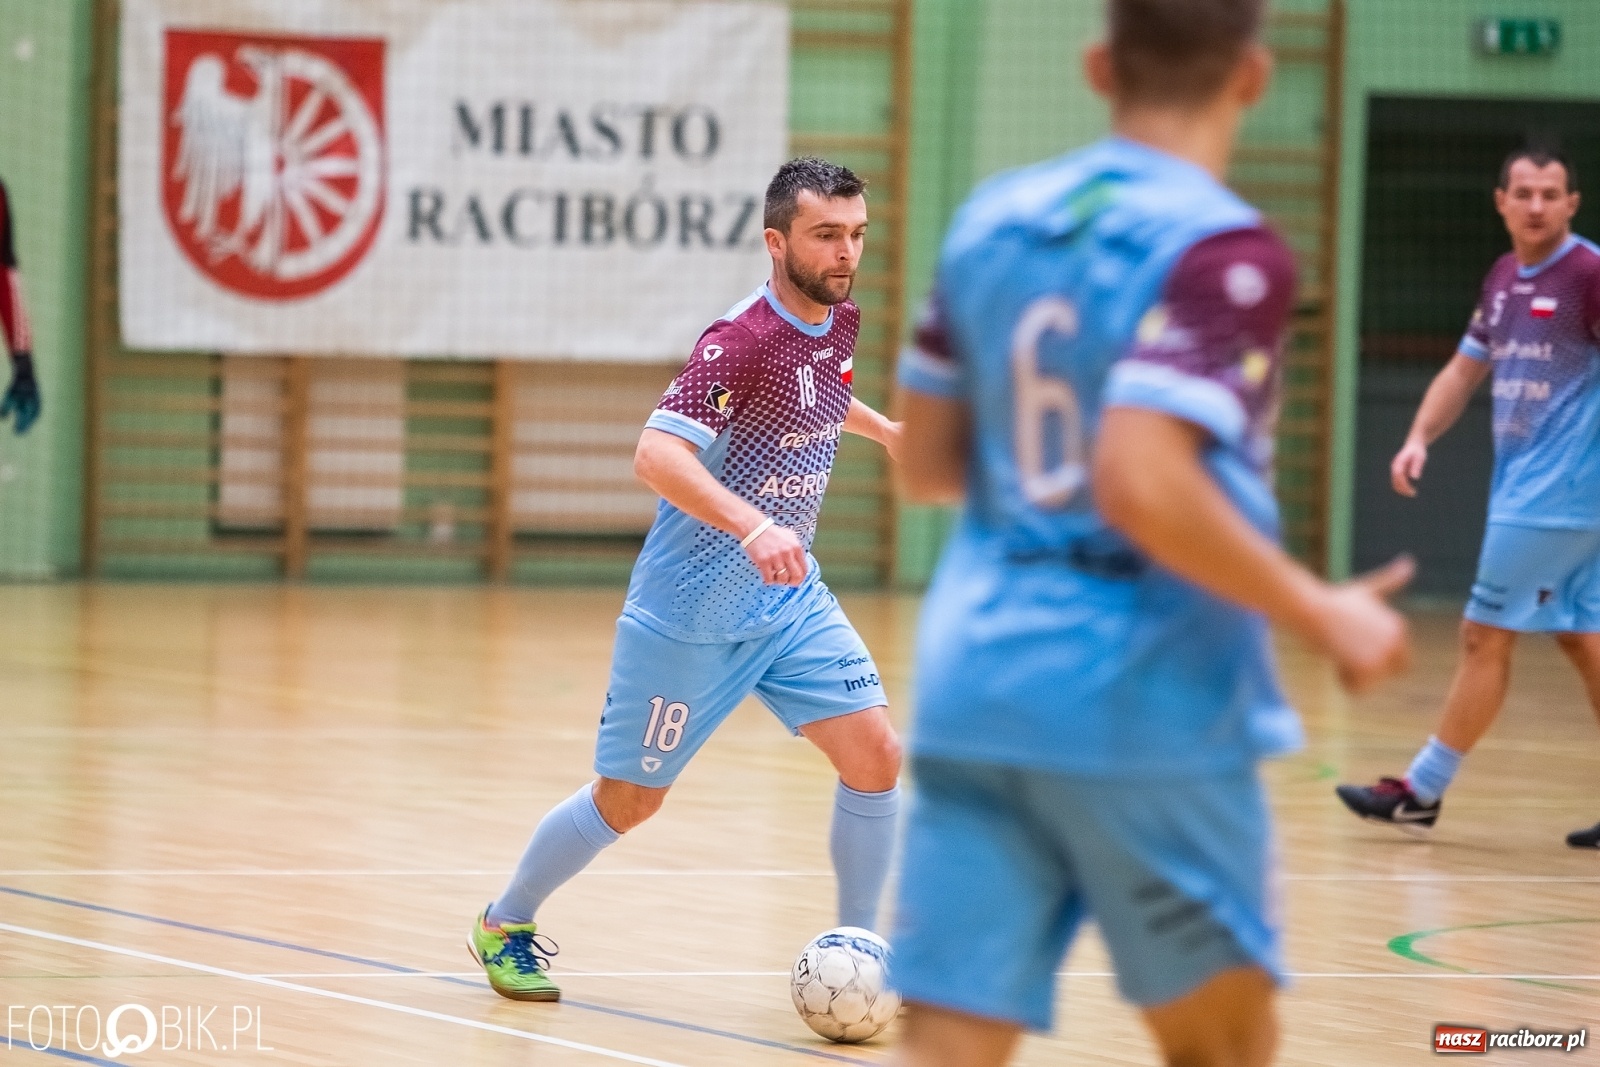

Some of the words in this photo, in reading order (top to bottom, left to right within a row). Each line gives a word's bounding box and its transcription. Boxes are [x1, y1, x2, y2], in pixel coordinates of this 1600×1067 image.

[451, 101, 722, 163] MIASTO
[404, 171, 765, 254] RACIBÓRZ
[795, 364, 817, 411] 18
[1011, 292, 1084, 510] 6
[757, 467, 832, 498] AGRO
[641, 695, 690, 752] 18
